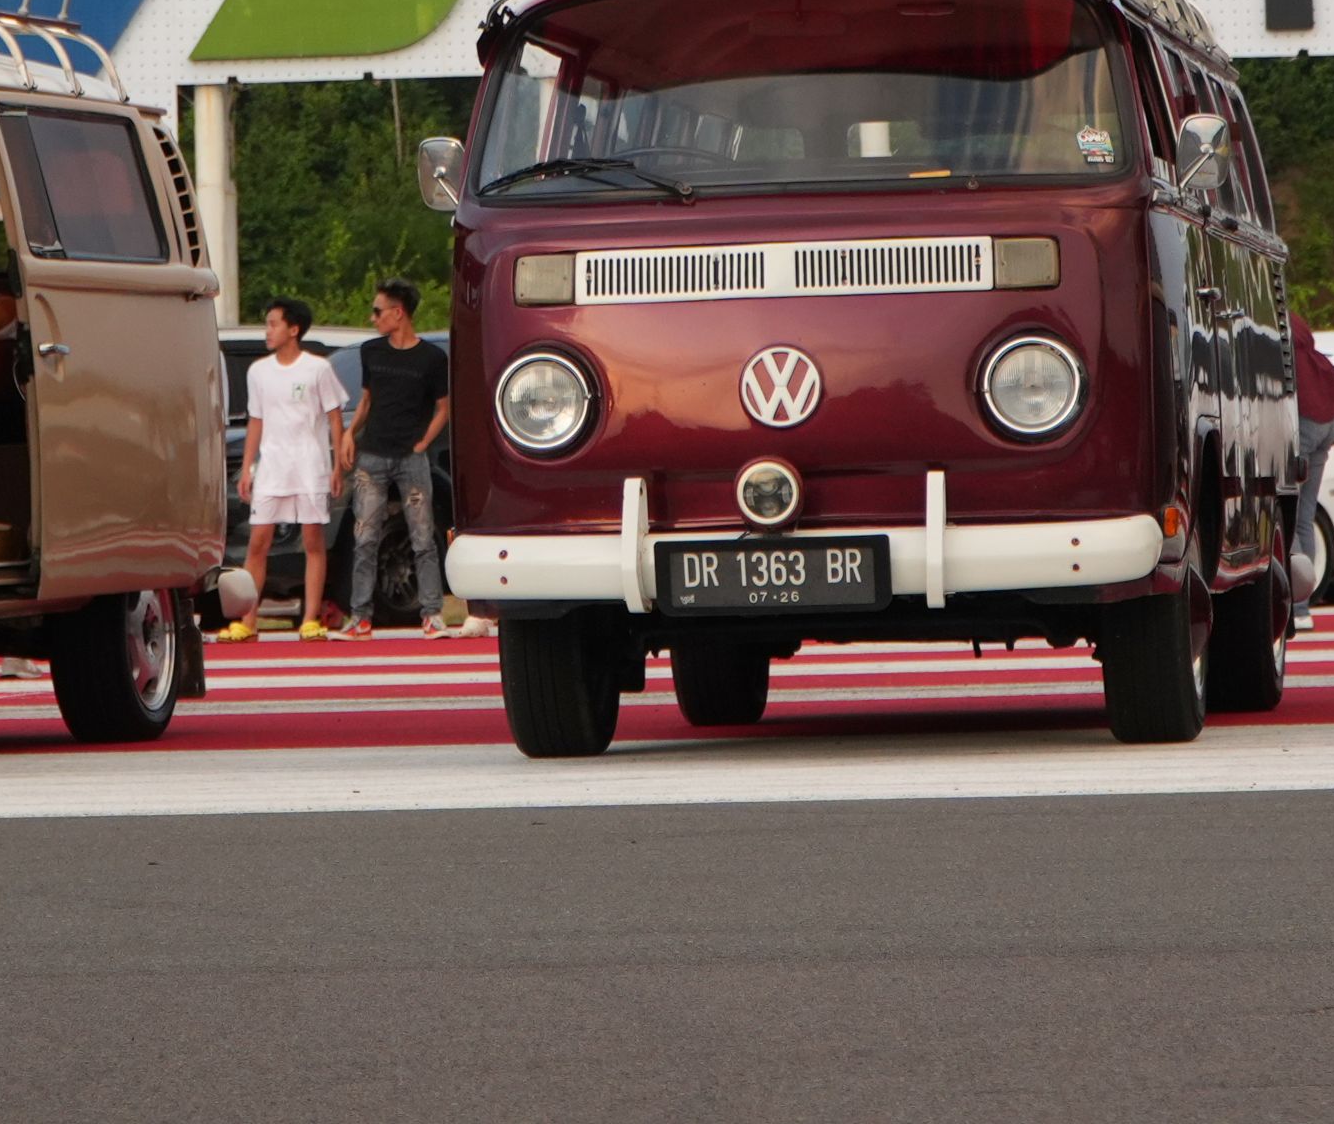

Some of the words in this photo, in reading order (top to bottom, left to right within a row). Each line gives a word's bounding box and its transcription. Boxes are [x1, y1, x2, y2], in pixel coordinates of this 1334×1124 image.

[683, 552, 719, 588] DR
[736, 550, 806, 587] 1363
[826, 548, 862, 584] BR
